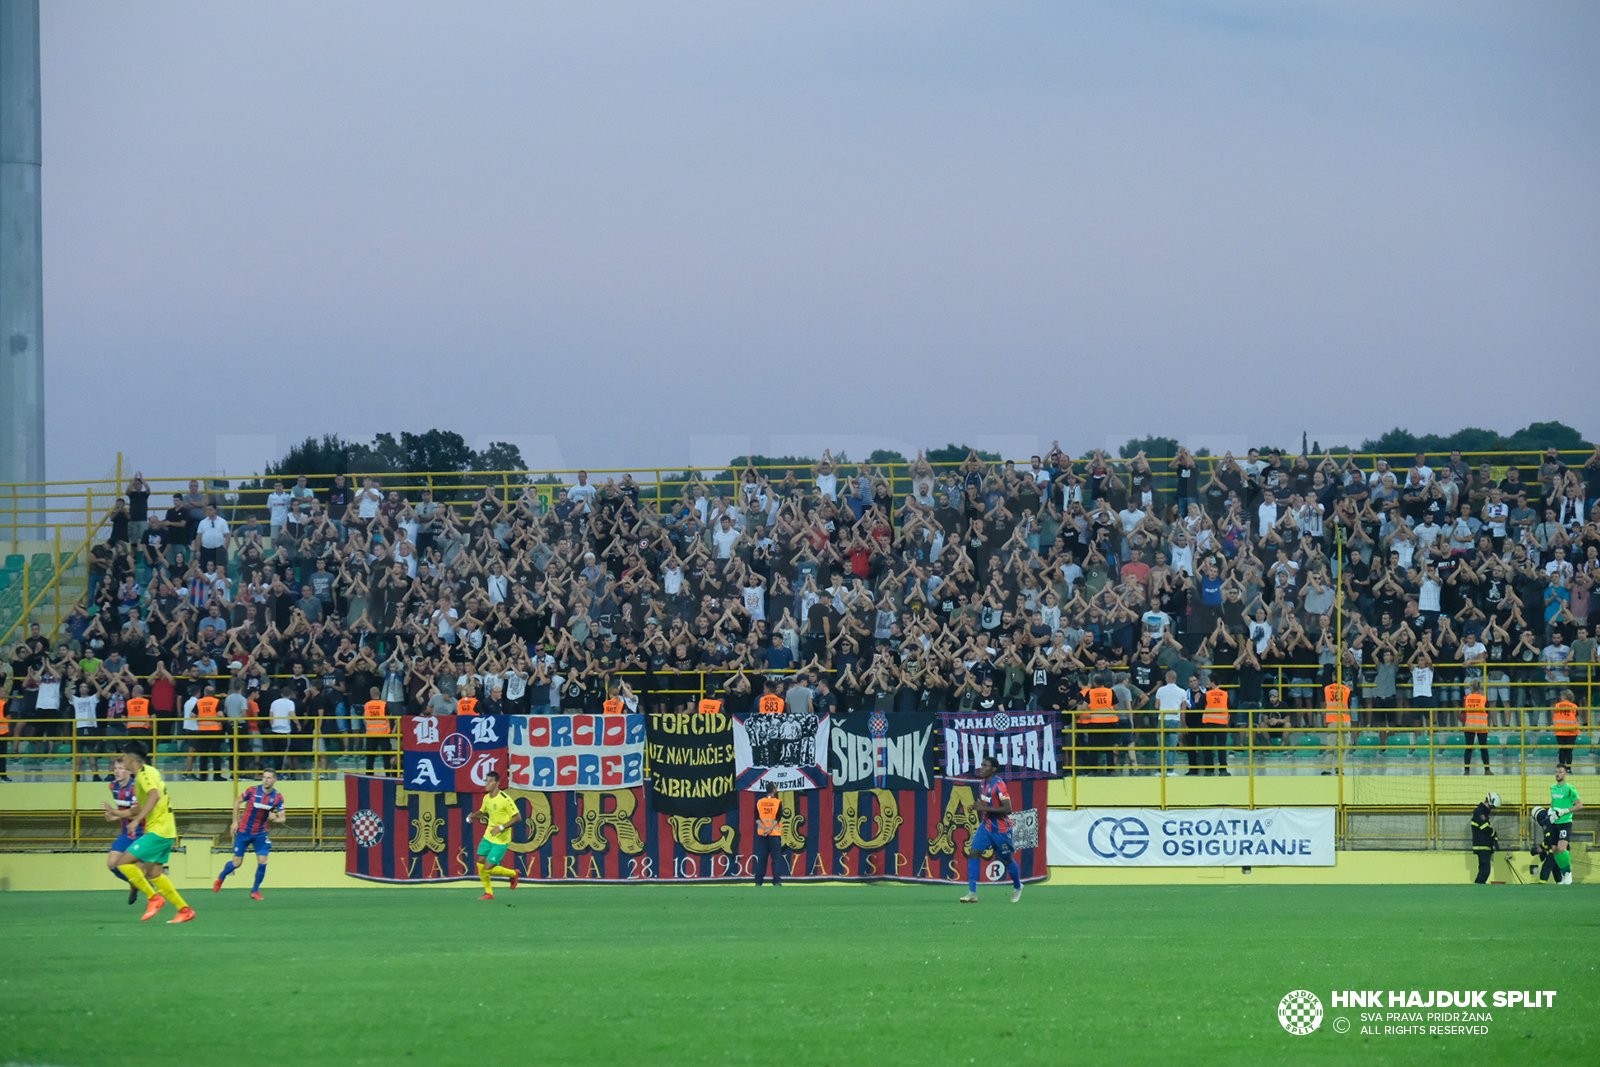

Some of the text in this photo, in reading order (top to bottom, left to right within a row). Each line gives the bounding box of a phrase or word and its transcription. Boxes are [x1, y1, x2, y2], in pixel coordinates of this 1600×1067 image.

[764, 700, 779, 712] 683
[509, 715, 646, 748] TORCIDA
[666, 744, 723, 766] NAVIJAČE
[831, 718, 934, 789] ŠIBENIK
[945, 724, 1058, 776] RIVIJERA
[411, 758, 441, 786] A
[509, 752, 643, 786] ZAGREB
[1162, 820, 1266, 836] CROATIA
[1162, 839, 1312, 856] OSIGURANJE
[627, 856, 658, 879] 28.
[673, 856, 698, 878] 10.
